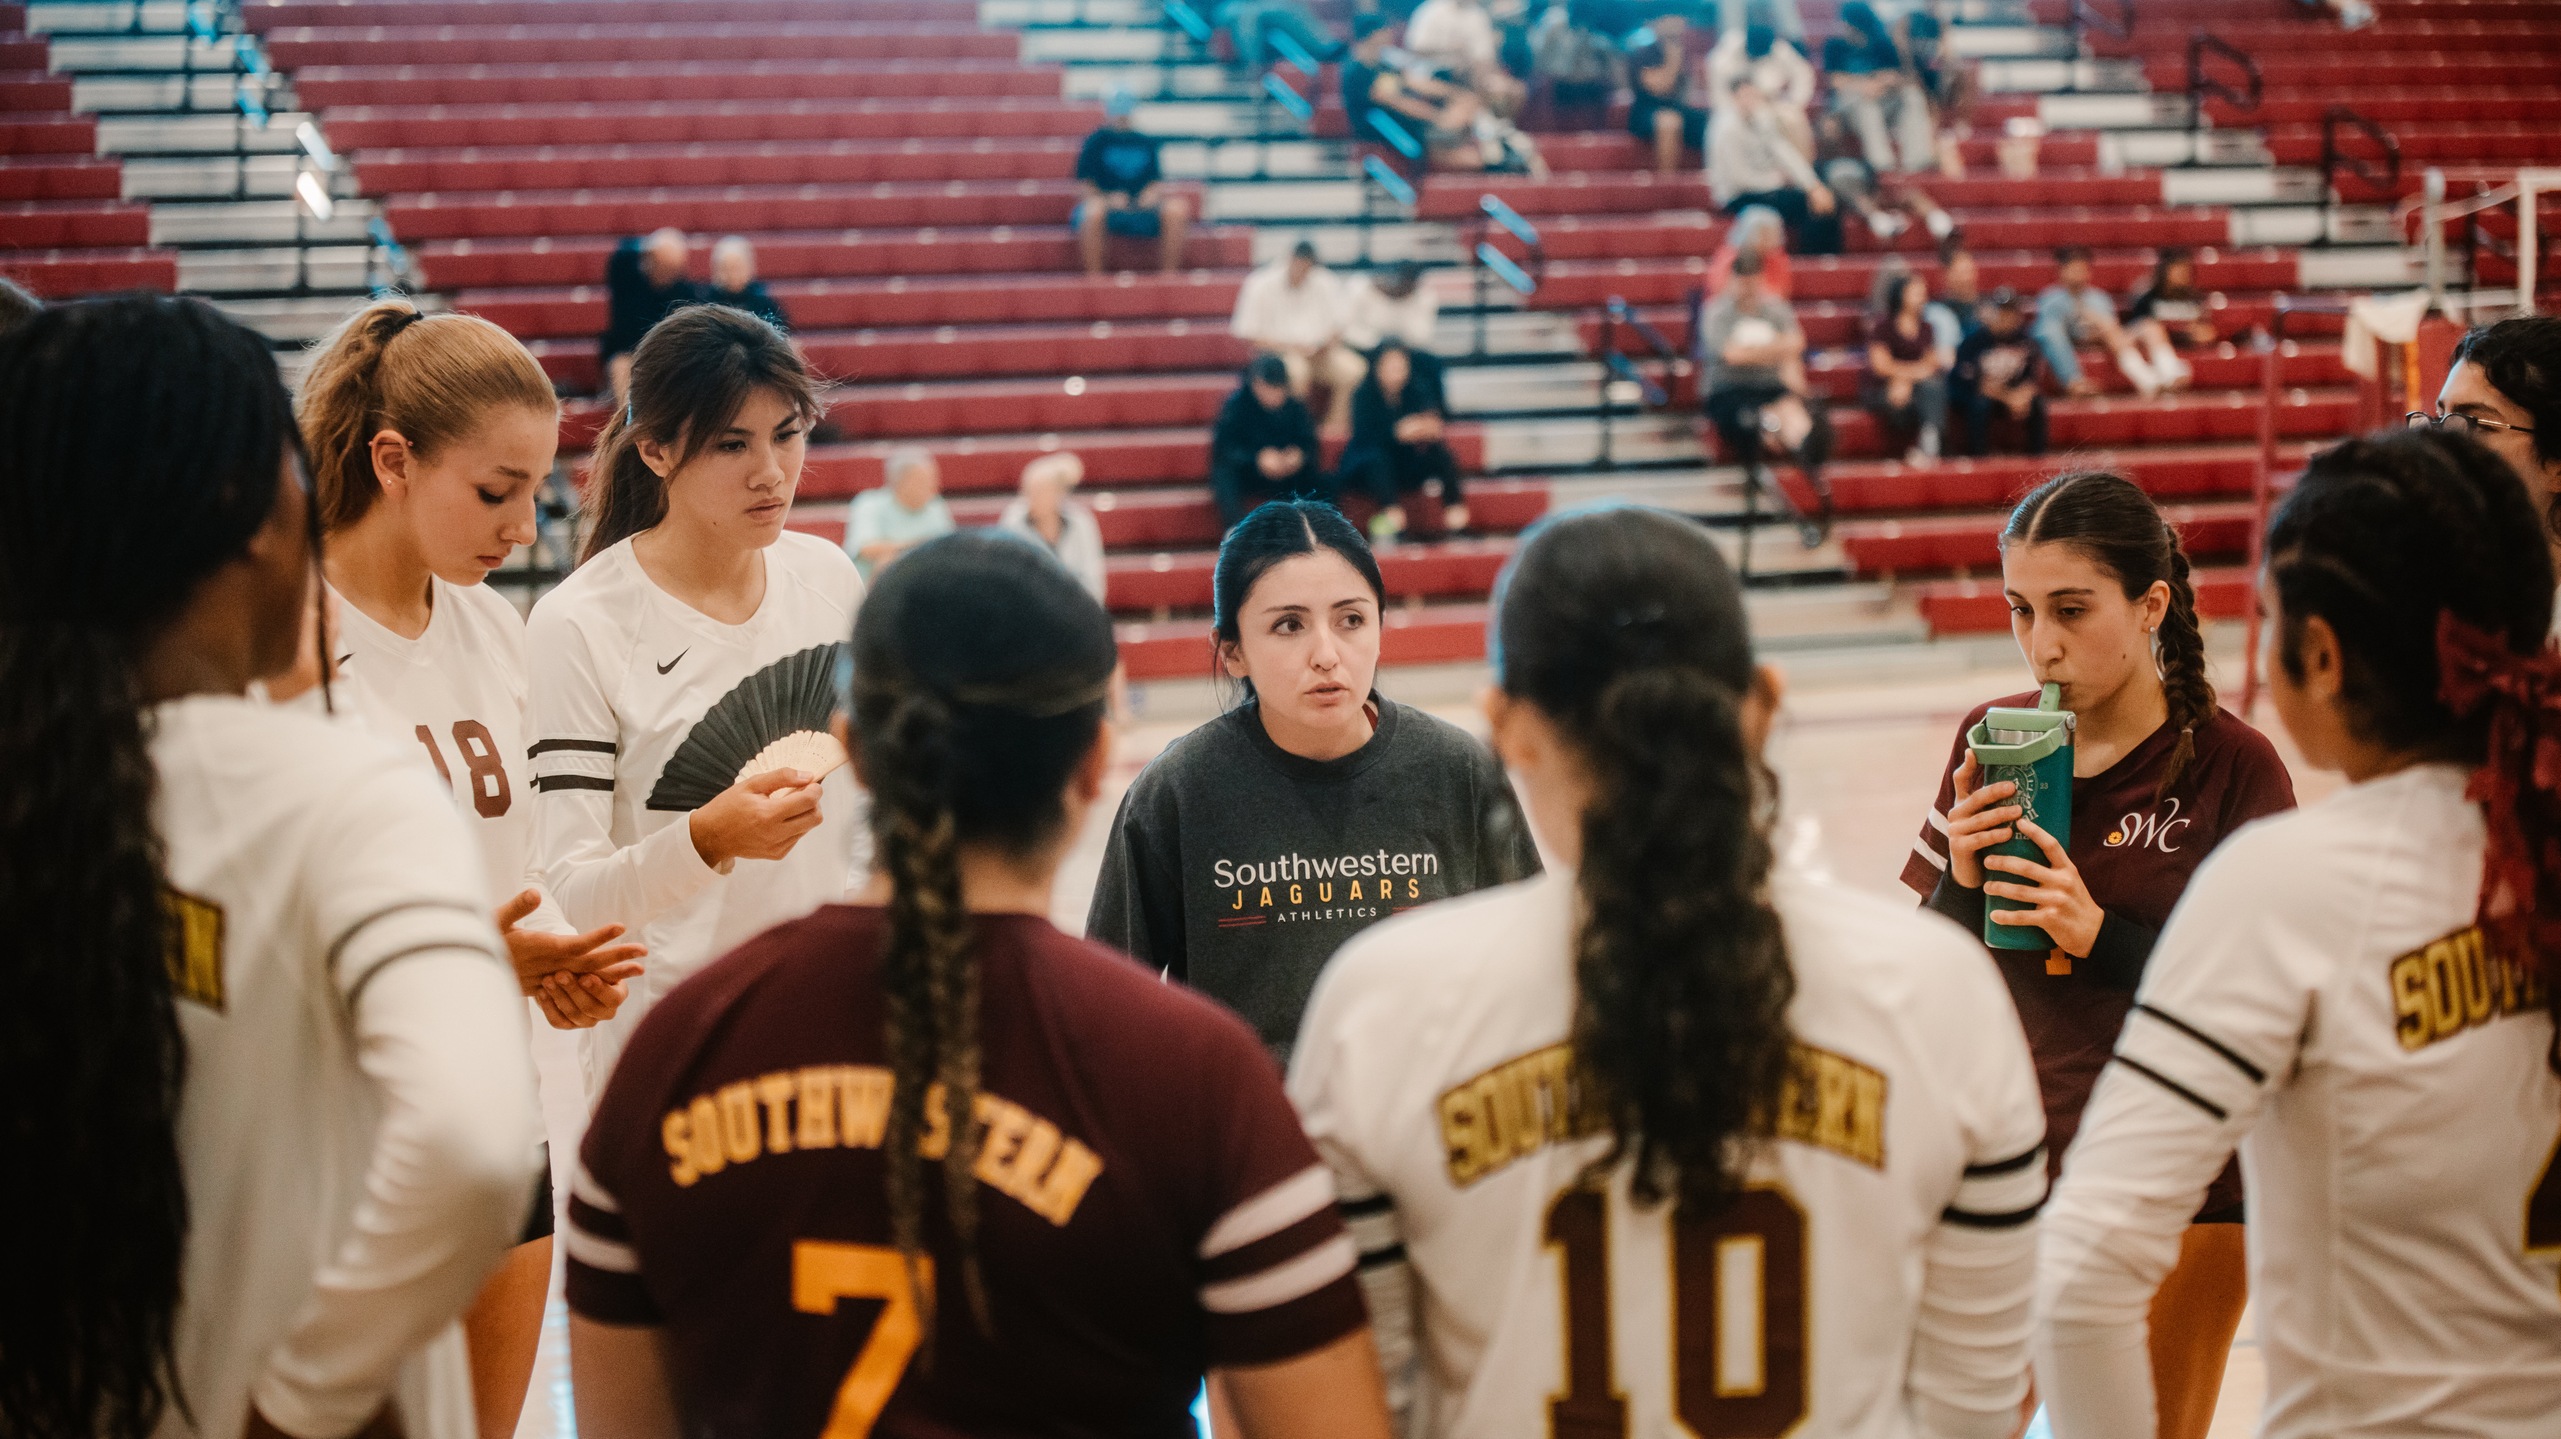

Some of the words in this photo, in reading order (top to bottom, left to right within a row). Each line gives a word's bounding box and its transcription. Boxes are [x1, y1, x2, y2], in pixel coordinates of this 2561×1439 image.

[415, 719, 512, 819] 18
[2103, 797, 2191, 853] SWC
[1214, 849, 1438, 888] Southwestern
[1232, 878, 1420, 910] JAGUARS
[1277, 907, 1378, 923] ATHLETICS
[1540, 1179, 1813, 1439] 10
[791, 1238, 937, 1439] 7
